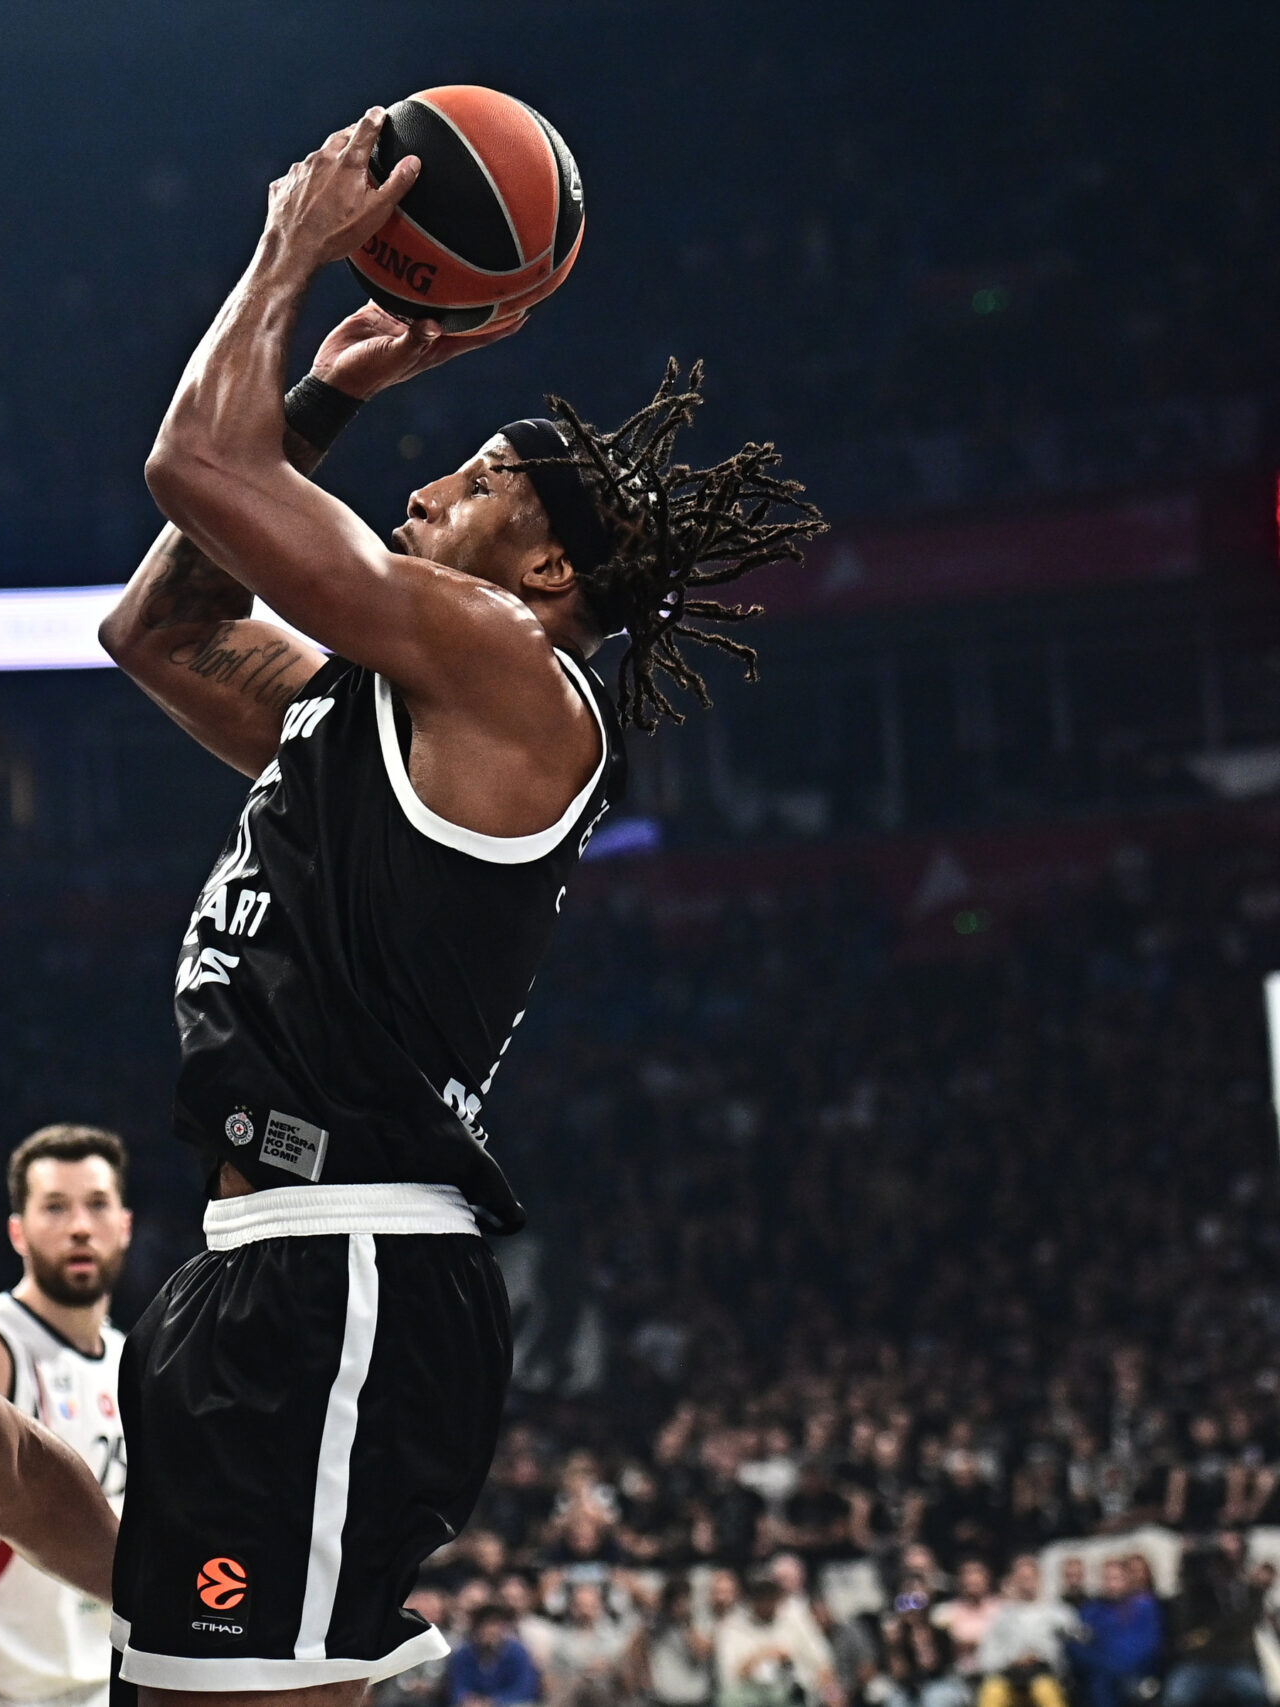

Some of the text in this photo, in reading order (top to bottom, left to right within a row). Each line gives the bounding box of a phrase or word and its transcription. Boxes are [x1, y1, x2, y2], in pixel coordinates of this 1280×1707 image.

[265, 1136, 283, 1148] KO
[268, 1128, 286, 1141] NE
[286, 1133, 317, 1153] IGRA
[191, 1621, 244, 1635] ETIHAD
